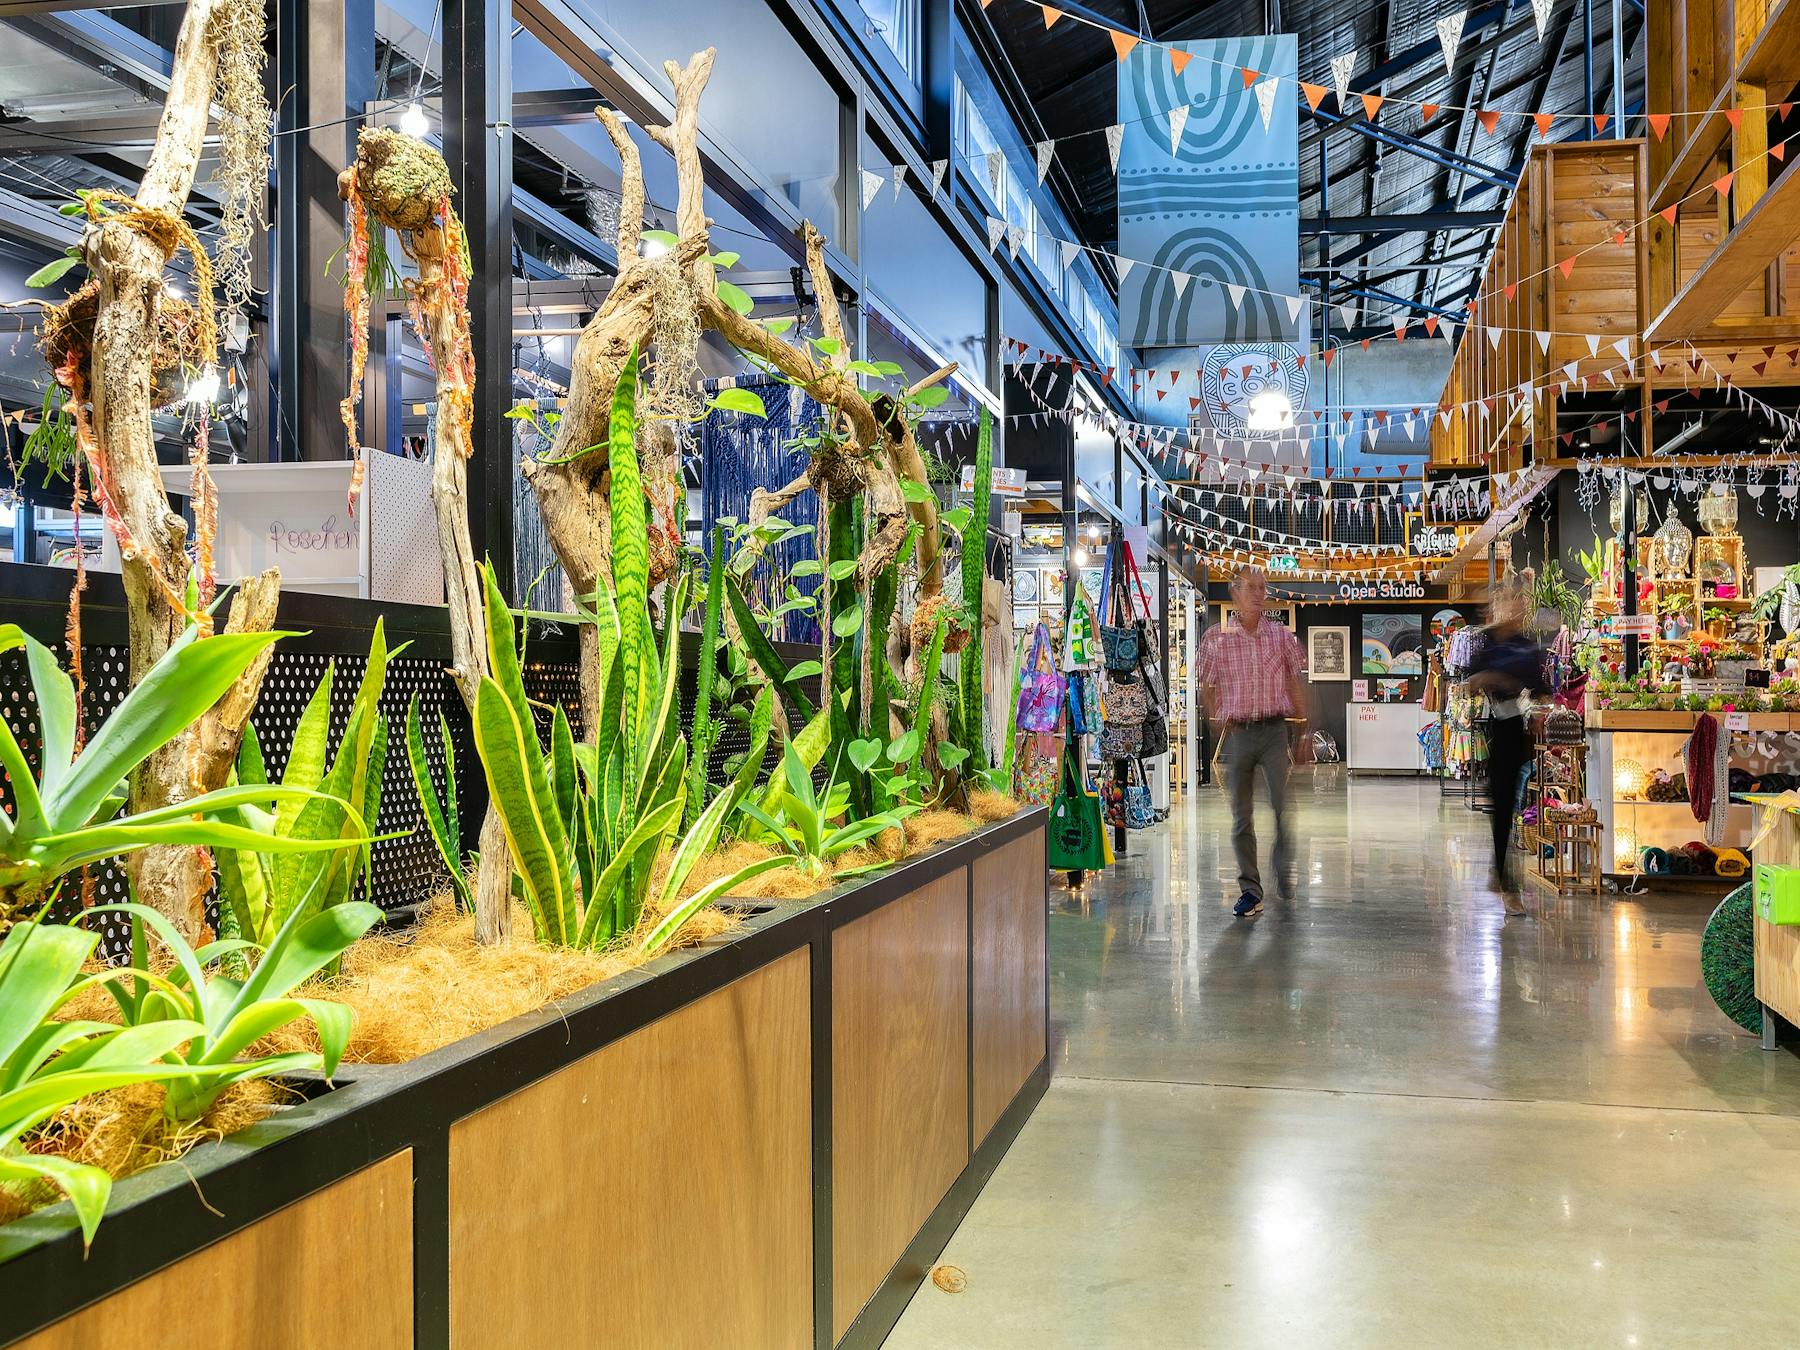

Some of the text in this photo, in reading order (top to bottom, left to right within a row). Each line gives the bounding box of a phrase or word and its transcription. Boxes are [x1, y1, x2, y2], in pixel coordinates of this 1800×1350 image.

[1339, 583, 1425, 600] Open Studio
[1361, 705, 1376, 713] PAY
